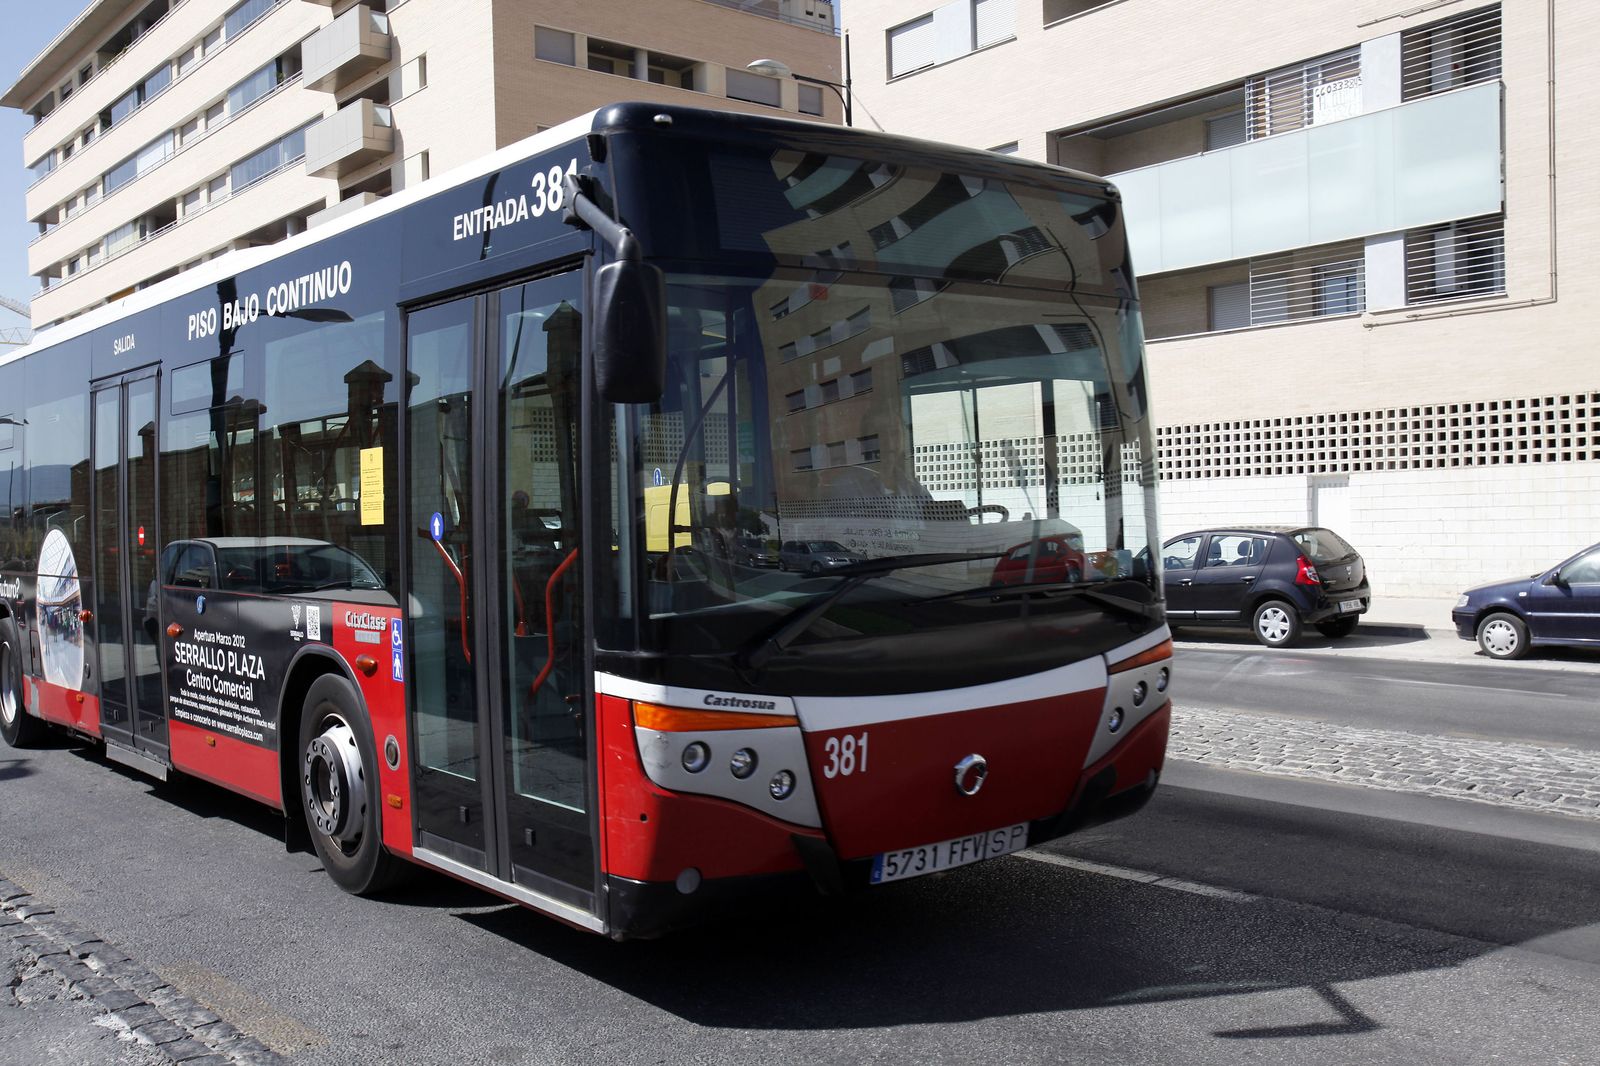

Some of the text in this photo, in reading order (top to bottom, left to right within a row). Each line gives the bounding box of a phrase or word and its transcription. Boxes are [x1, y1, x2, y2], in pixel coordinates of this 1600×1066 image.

[453, 194, 529, 241] ENTRADA
[188, 260, 352, 341] PISO BAJO CONTINUO
[113, 333, 136, 356] SALIDA
[193, 628, 246, 648] Apertura Marzo 2012
[345, 610, 387, 631] CityClass
[174, 641, 265, 681] SERRALLO PLAZA
[186, 668, 254, 702] Centro Comercial
[703, 694, 776, 710] Castrosua
[823, 731, 868, 779] 381
[886, 825, 1024, 876] 5731 FFV SP
